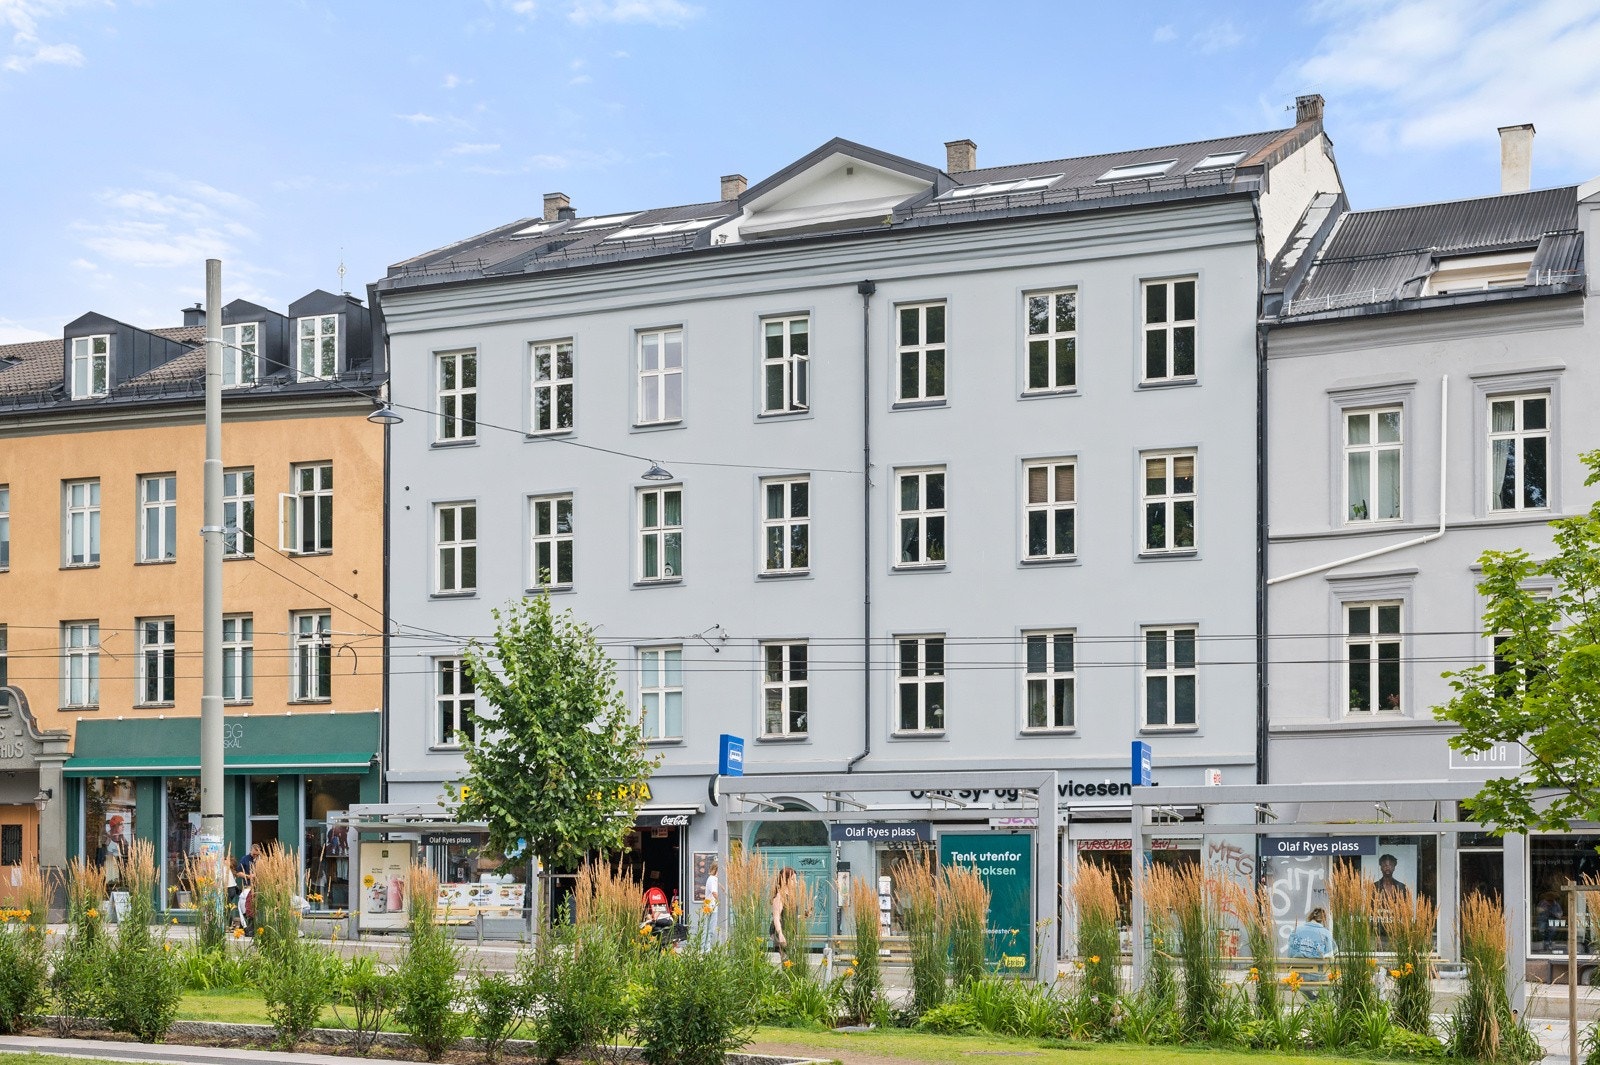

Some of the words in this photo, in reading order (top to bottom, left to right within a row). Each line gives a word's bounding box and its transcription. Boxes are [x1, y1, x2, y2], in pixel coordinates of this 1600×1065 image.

[845, 827, 865, 837] Olaf
[867, 827, 890, 839] Ryes
[891, 827, 916, 838] plass
[429, 836, 441, 844] Olaf
[442, 836, 456, 845] Ryes
[456, 836, 472, 845] plass
[1277, 841, 1300, 852] Olaf
[1303, 841, 1329, 854] Ryes
[1331, 841, 1360, 853] plass
[950, 851, 977, 862] Tenk
[979, 851, 1022, 862] utenfor
